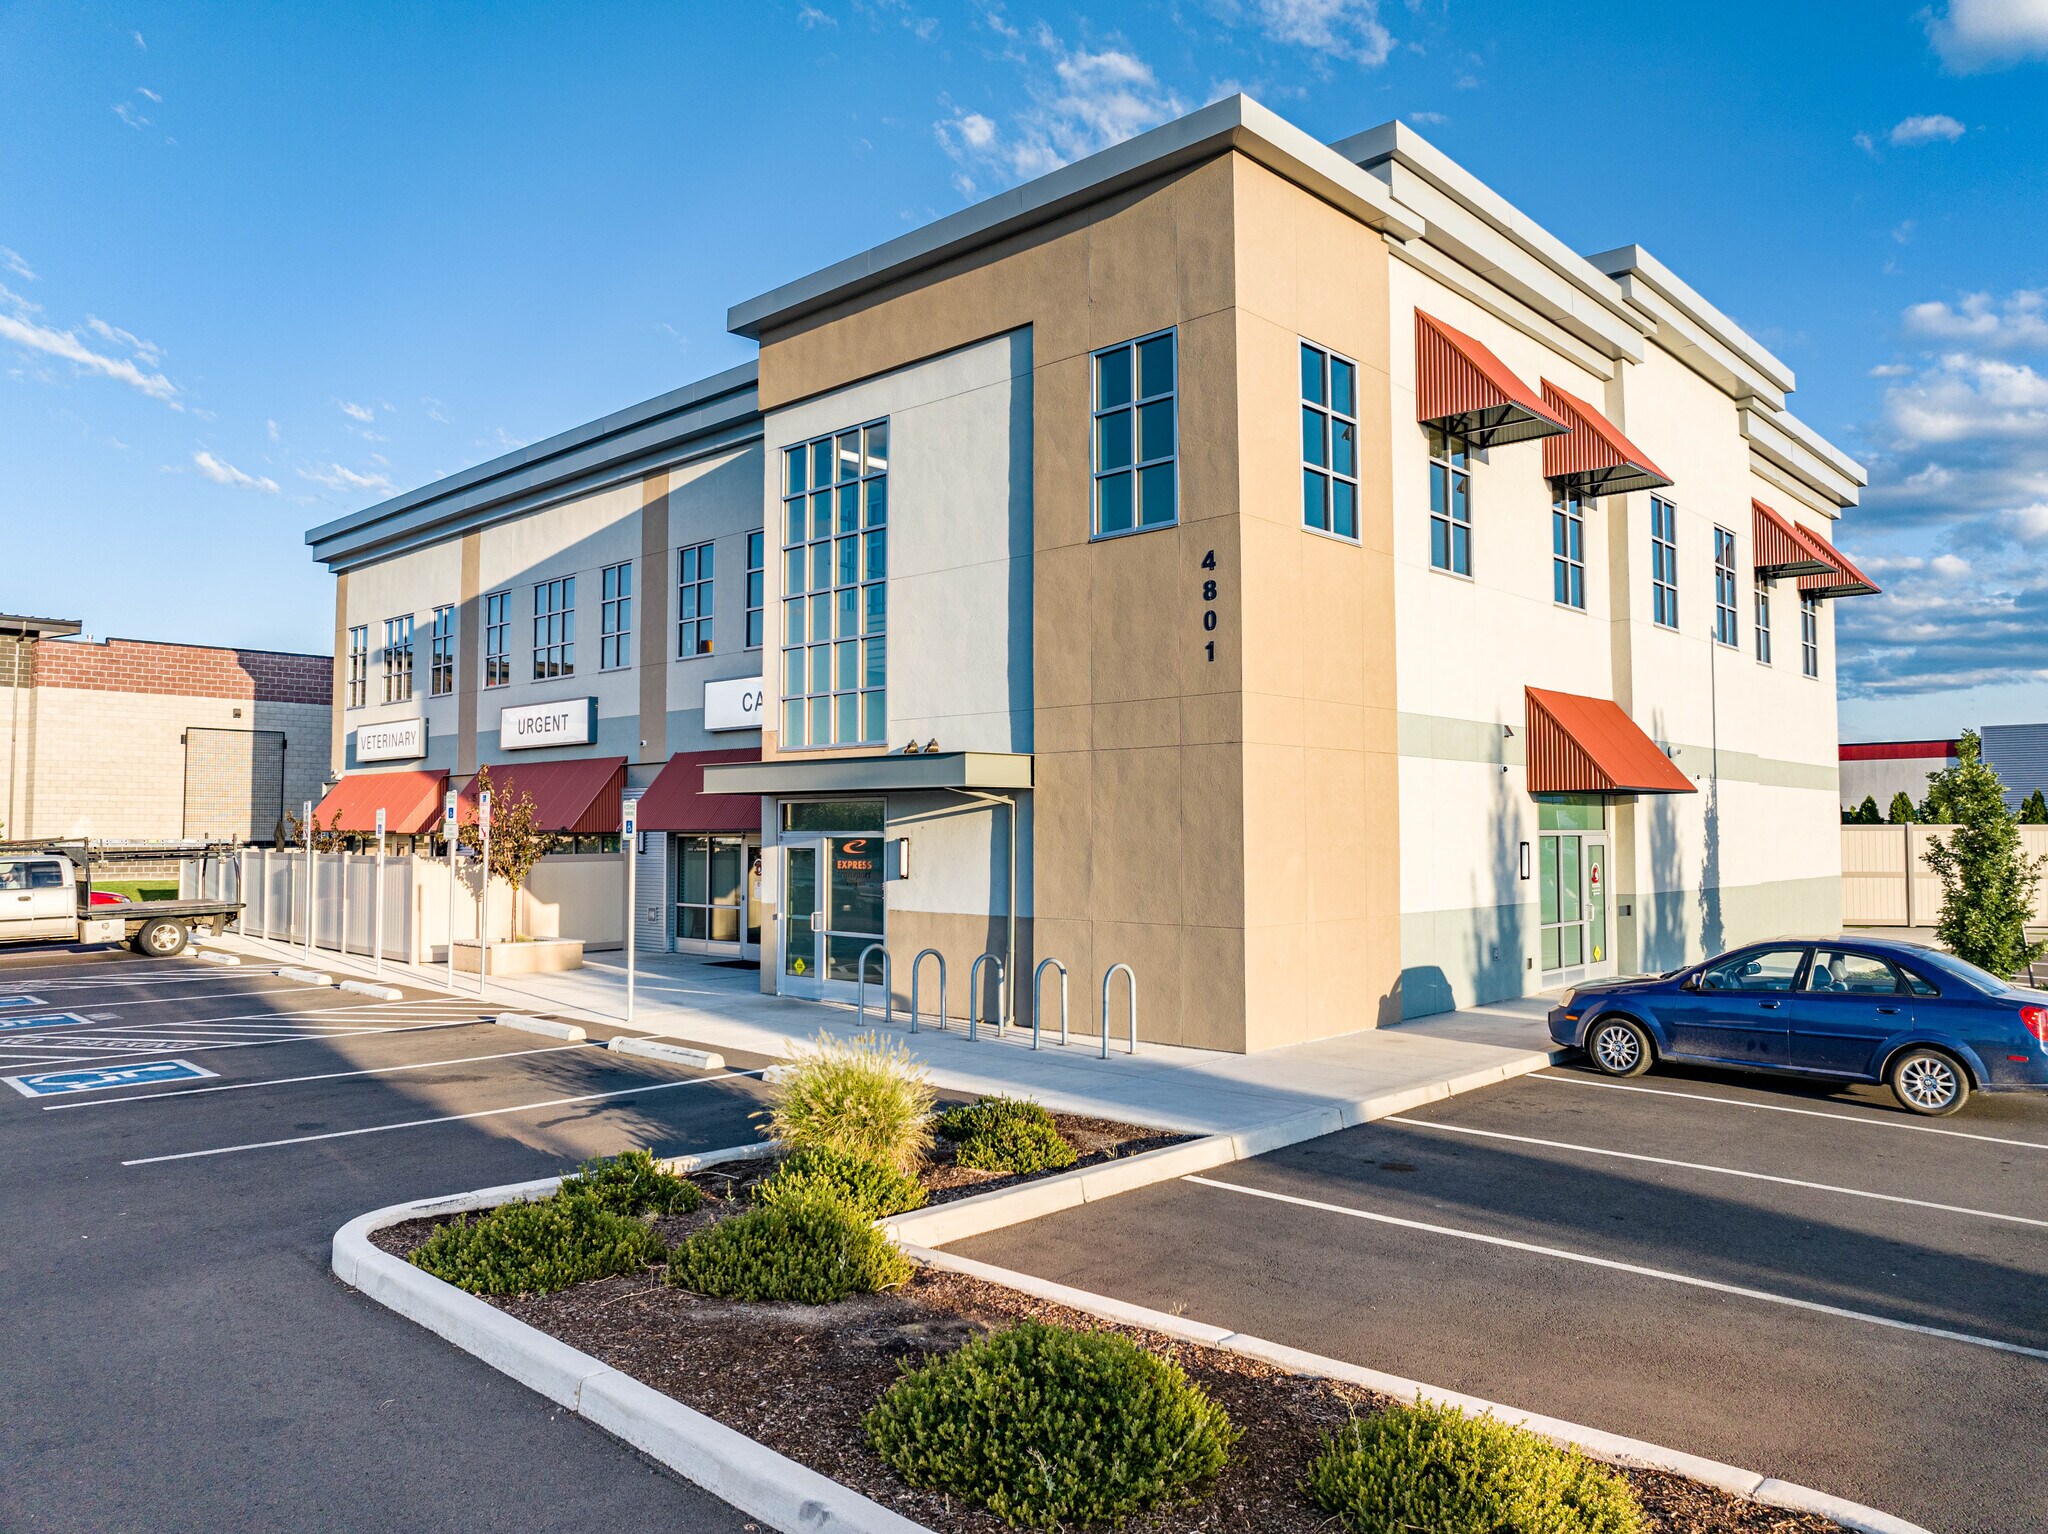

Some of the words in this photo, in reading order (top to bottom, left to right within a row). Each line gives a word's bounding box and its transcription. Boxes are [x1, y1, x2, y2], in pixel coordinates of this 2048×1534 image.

[1201, 550, 1217, 662] 4801
[518, 714, 569, 735] URGENT
[361, 730, 417, 750] VETERINARY
[837, 860, 873, 870] EXPRESS
